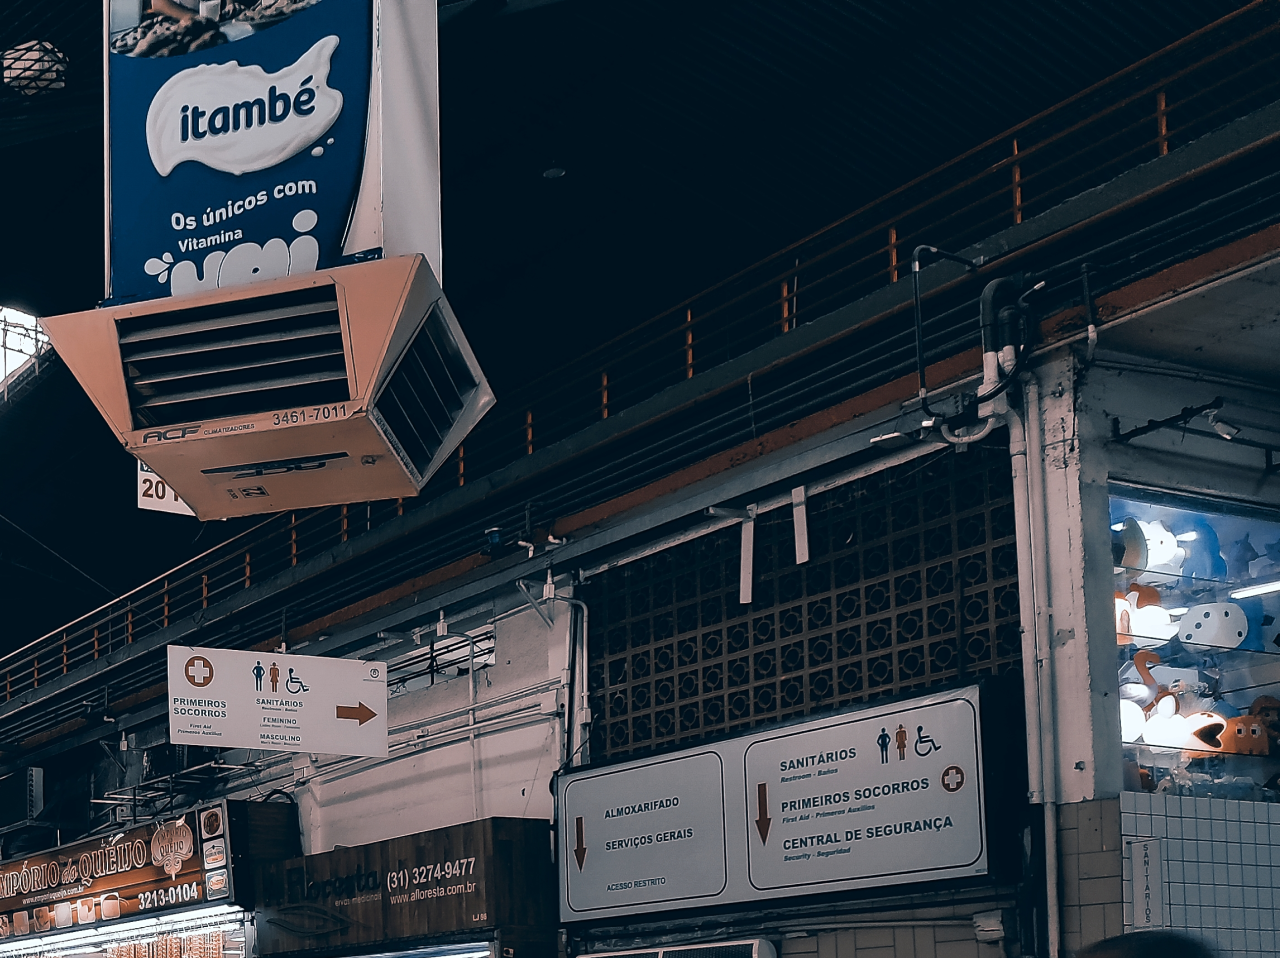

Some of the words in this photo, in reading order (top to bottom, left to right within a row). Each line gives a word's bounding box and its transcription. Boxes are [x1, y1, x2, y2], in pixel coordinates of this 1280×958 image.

[180, 75, 317, 143] itambé
[171, 212, 197, 230] Os
[202, 190, 269, 227] únicos
[273, 180, 317, 199] com
[178, 228, 243, 252] Vitamina
[142, 425, 202, 444] ACF
[272, 404, 348, 426] 3461-7011
[173, 697, 227, 708] PRIMEIROS
[173, 707, 227, 718] SOCORROS
[263, 717, 297, 725] FEMININO
[260, 733, 301, 742] MASCULINO
[780, 747, 857, 772] SANITÁRIOS
[781, 791, 850, 813] PRIMEIROS
[854, 777, 930, 800] SOCORROS
[604, 796, 680, 819] ALMOXARIFADO
[782, 815, 798, 824] First
[799, 813, 810, 822] Aid
[605, 835, 653, 851] SERVIÇOS
[656, 828, 694, 843] GERAIS
[783, 832, 842, 851] CENTRAL
[845, 829, 862, 842] DE
[866, 816, 954, 840] SEGURANÇA
[79, 839, 147, 887] QUEIJO
[783, 852, 812, 863] Security
[387, 868, 409, 892] (31)
[412, 857, 476, 884] 3274-9477
[606, 880, 632, 892] ACESSO
[633, 877, 666, 888] RESTRITO
[138, 881, 198, 910] 3213-0104
[390, 880, 476, 905] www.afloresta.com.br
